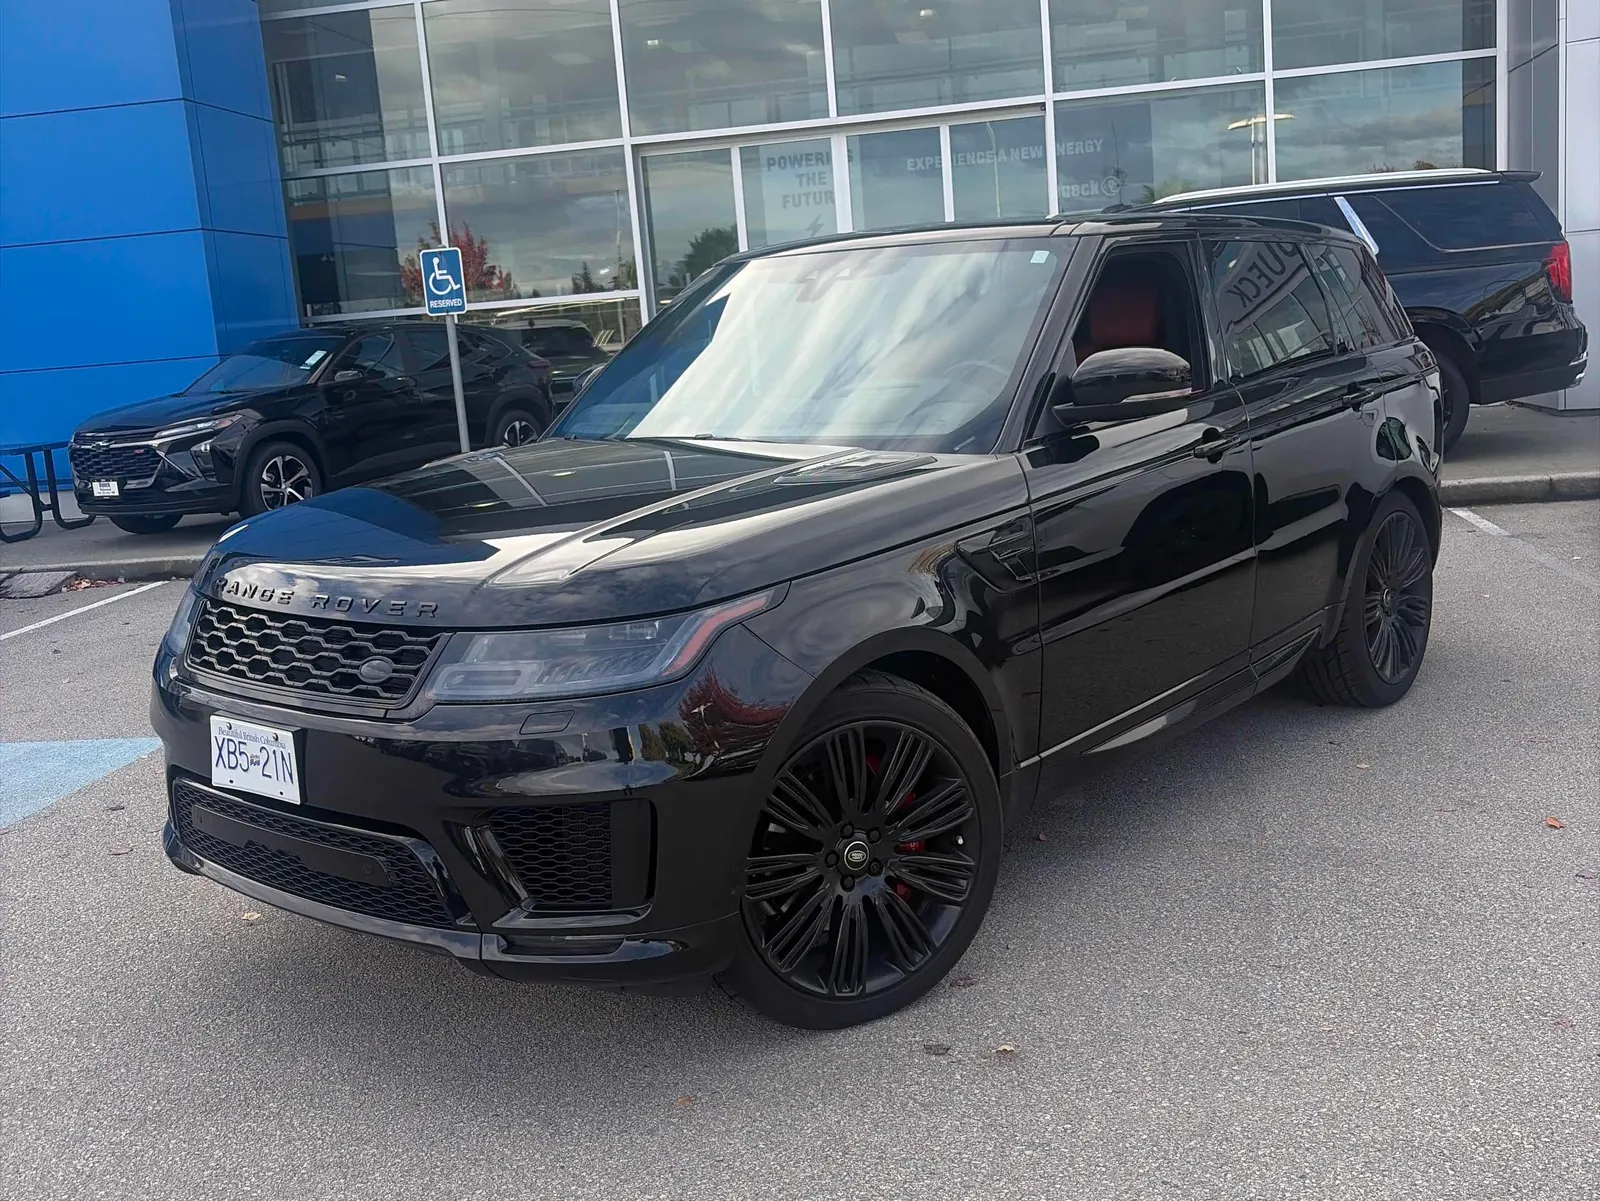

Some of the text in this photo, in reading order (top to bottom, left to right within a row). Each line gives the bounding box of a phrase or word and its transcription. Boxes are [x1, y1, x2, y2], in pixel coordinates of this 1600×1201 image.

[766, 148, 854, 172] POWERIG
[906, 138, 1104, 172] EXPEIENCE A NEW NERGY
[796, 171, 827, 188] THE
[1060, 179, 1100, 198] ueck
[782, 190, 835, 209] FUTUR
[430, 298, 463, 309] RESERVED
[213, 577, 439, 618] RANGE ROVER
